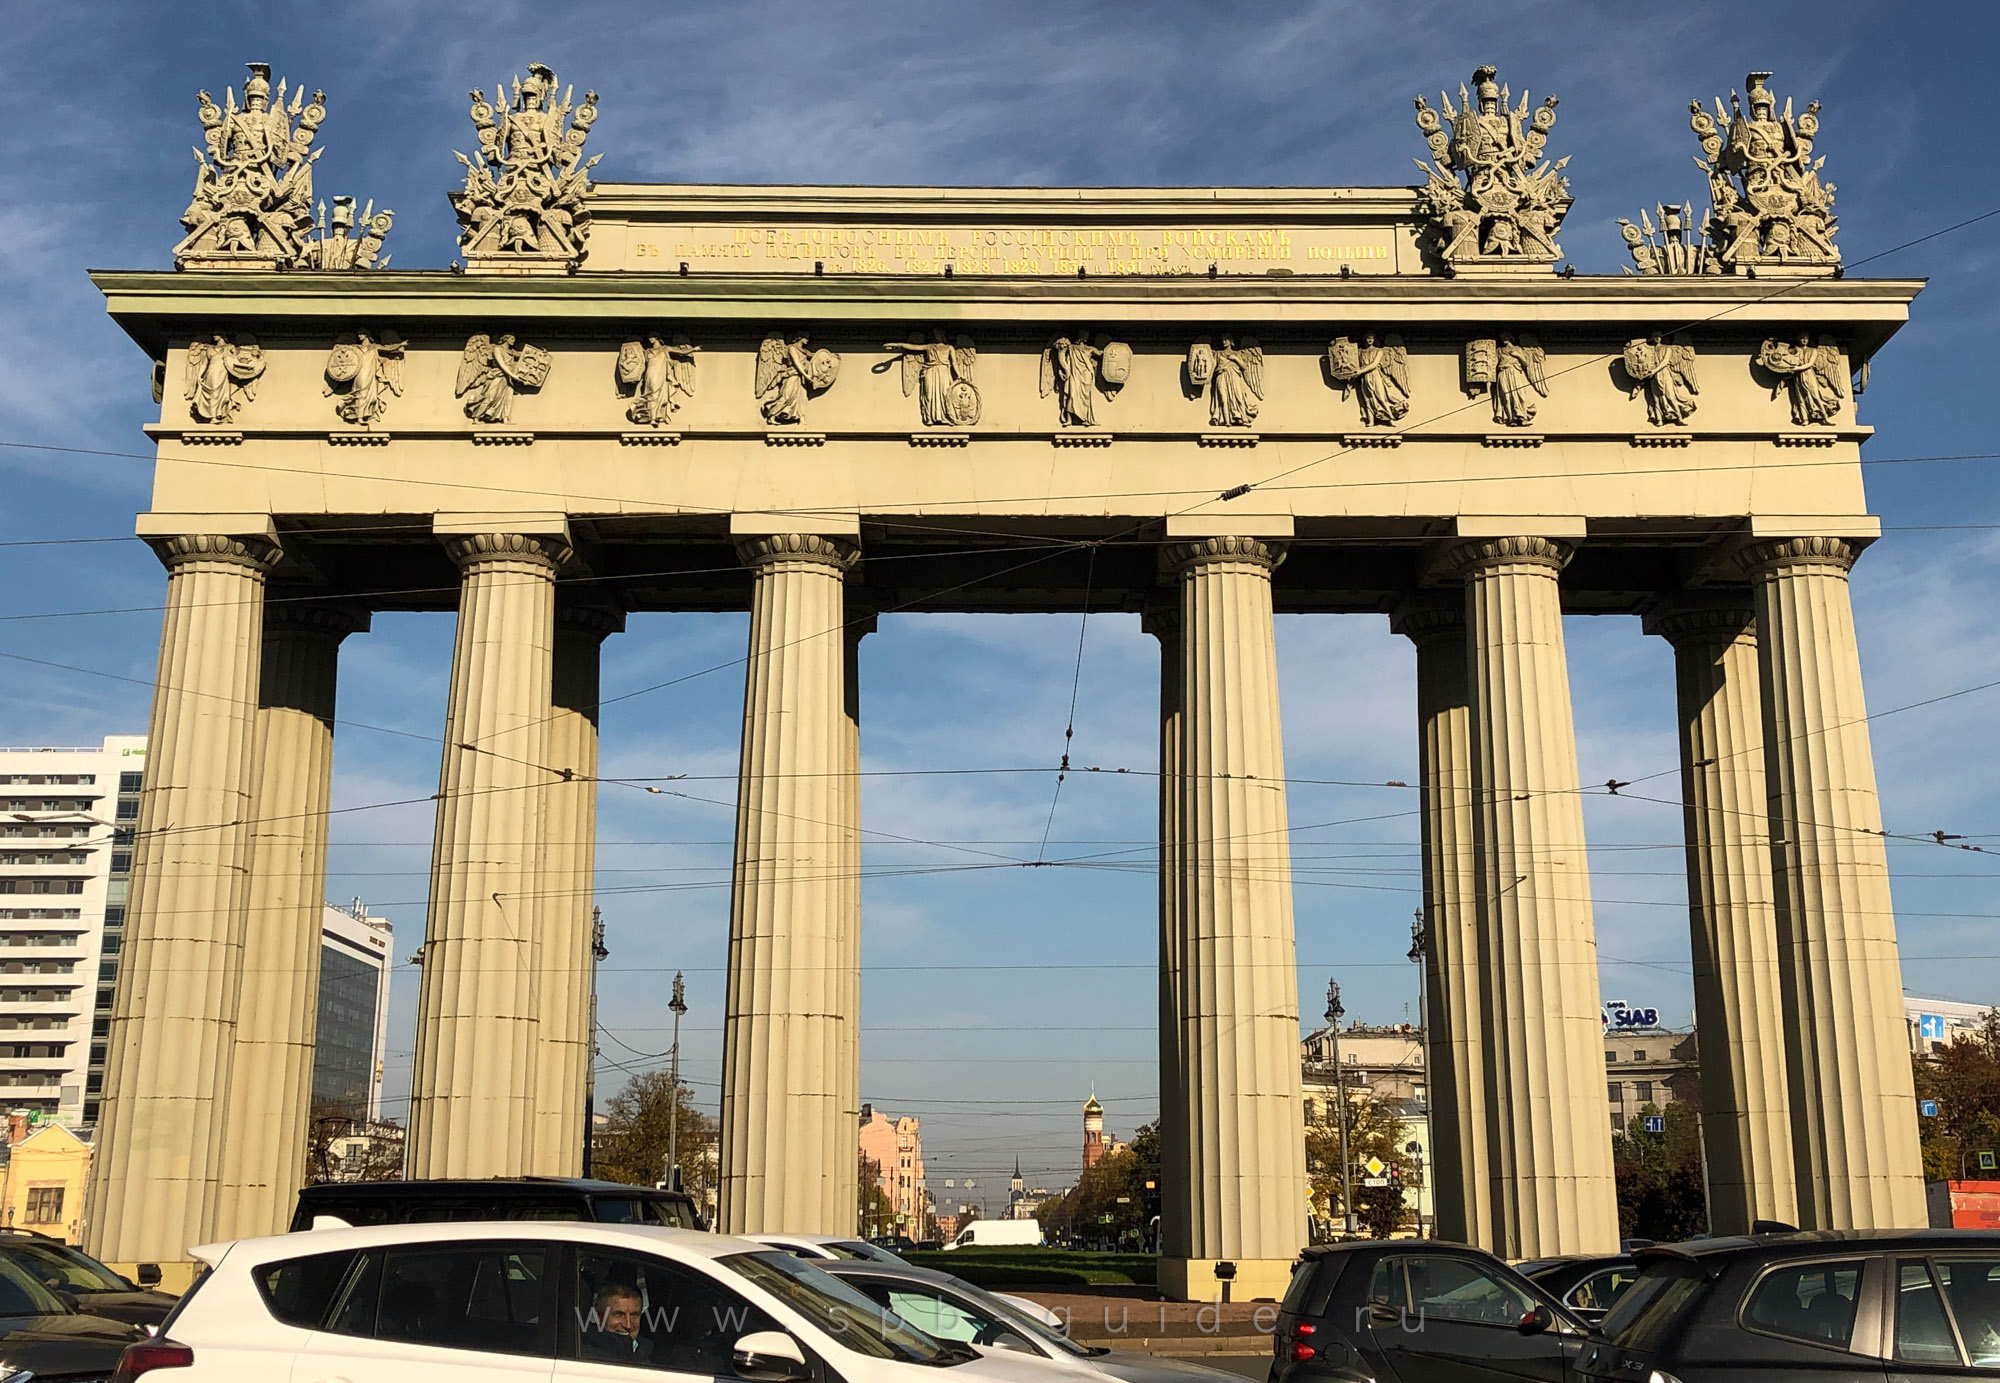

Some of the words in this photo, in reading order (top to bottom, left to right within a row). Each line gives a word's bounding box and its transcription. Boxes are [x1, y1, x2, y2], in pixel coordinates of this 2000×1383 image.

[1161, 229, 1292, 247] ВОЙСКАМЪ
[636, 243, 661, 257] ВЪ
[674, 244, 752, 258] ПАМЯТЬ
[765, 244, 877, 260] ПОДВИГОВЪ
[894, 246, 919, 259] ВЪ
[1106, 247, 1118, 260] И
[1130, 247, 1169, 260] ПРИ
[1306, 246, 1388, 260] ПОЛЬШИ
[1108, 260, 1143, 274] 1831
[1614, 1008, 1659, 1027] SIAB
[1621, 1359, 1645, 1371] X3
